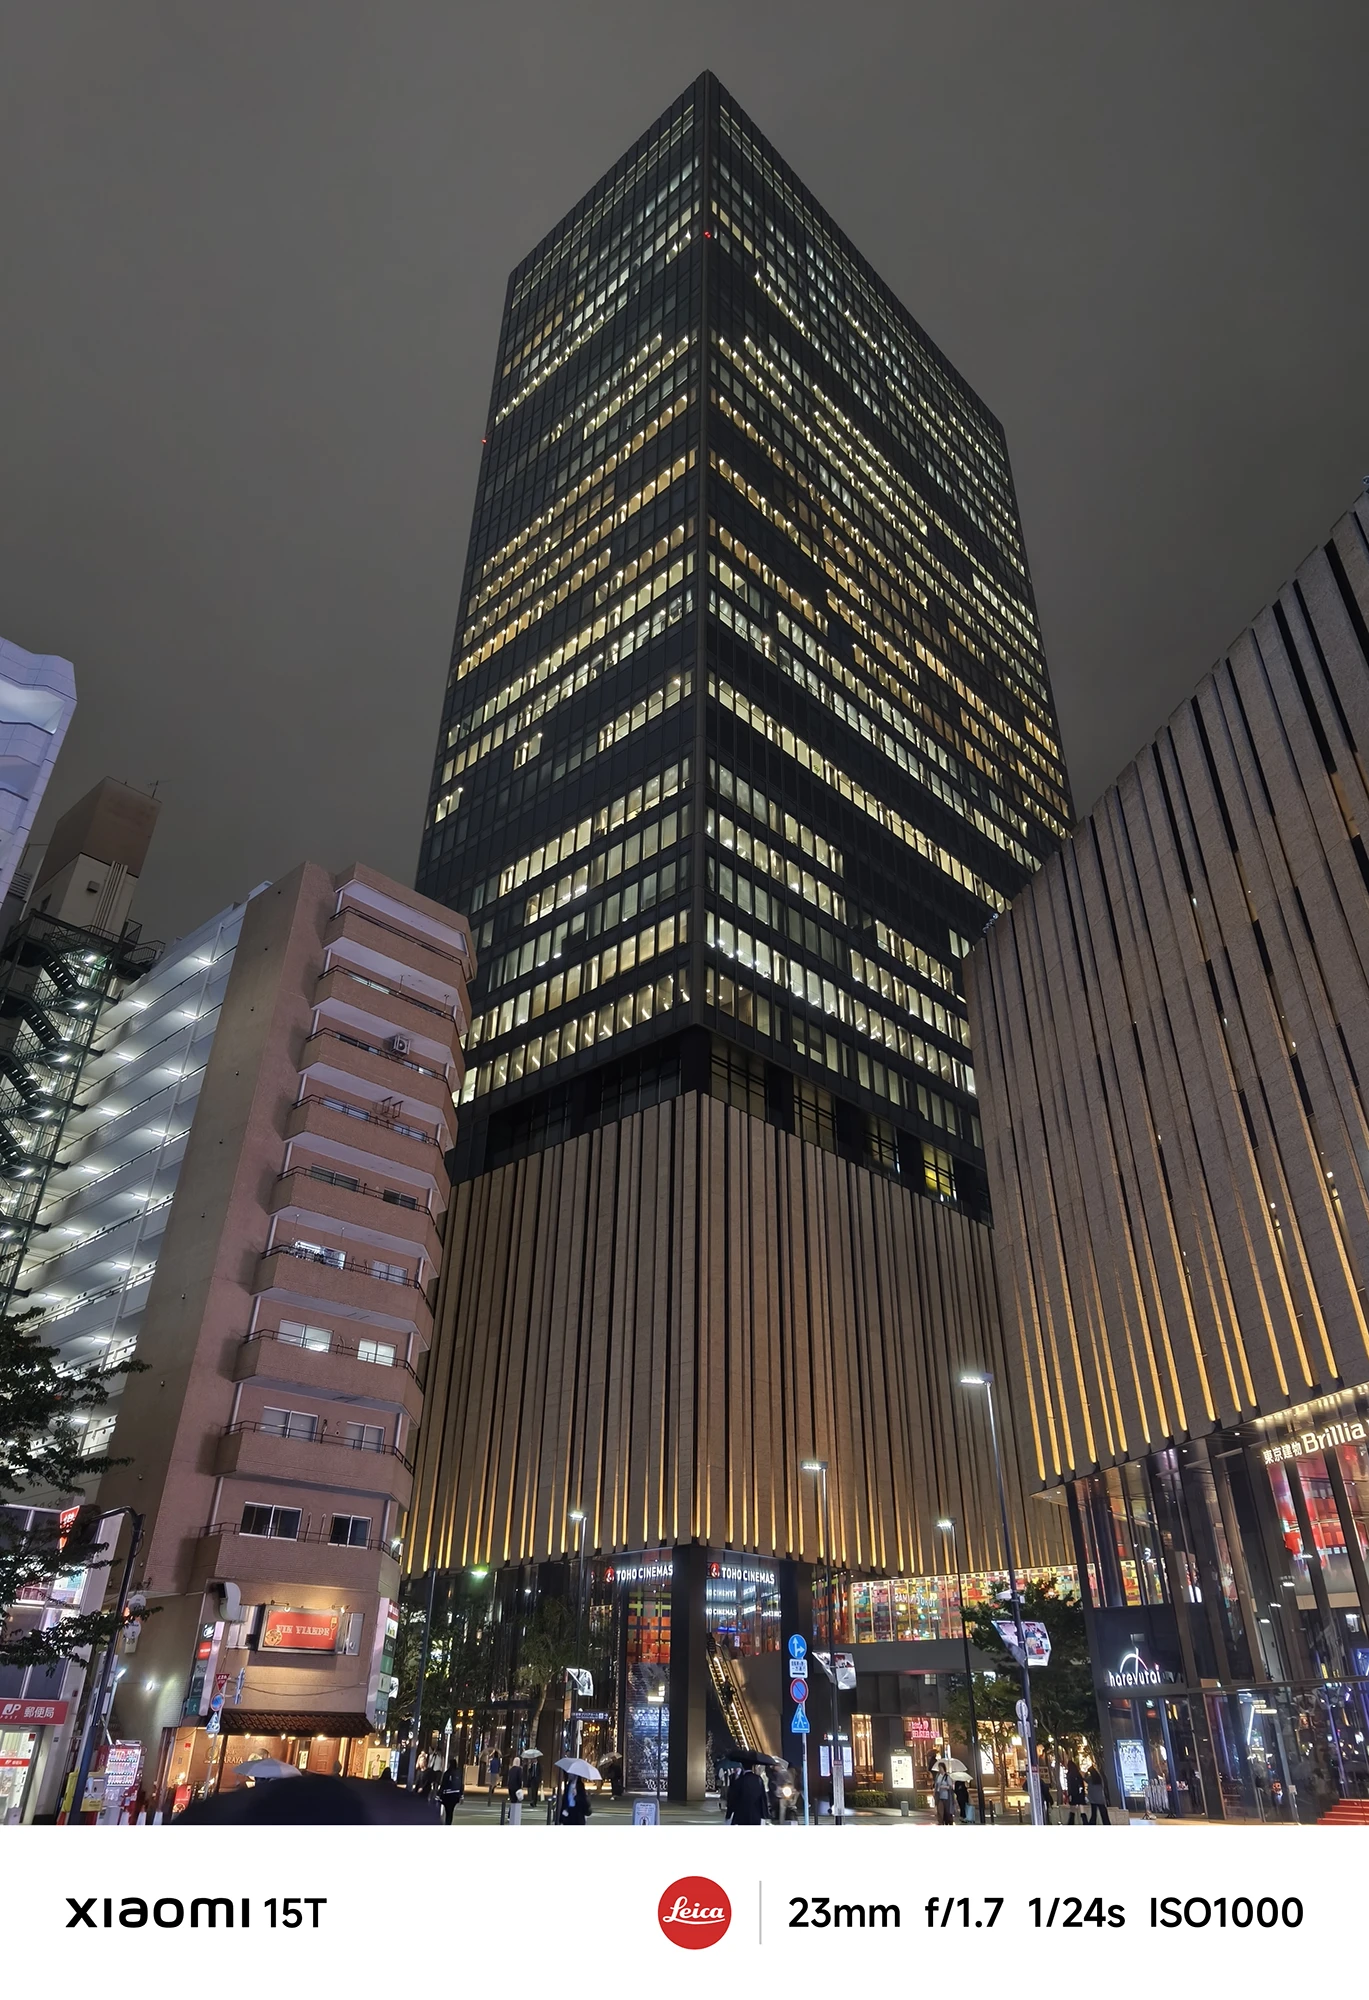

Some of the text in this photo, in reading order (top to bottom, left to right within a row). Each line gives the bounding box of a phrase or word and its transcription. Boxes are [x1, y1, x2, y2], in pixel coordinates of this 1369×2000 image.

[1262, 1422, 1367, 1465] 東京建物 Brillia
[616, 1564, 674, 1581] TOHO CINEMAS
[721, 1567, 775, 1584] TOHO CINEMAS
[24, 1706, 55, 1719] 郵便局
